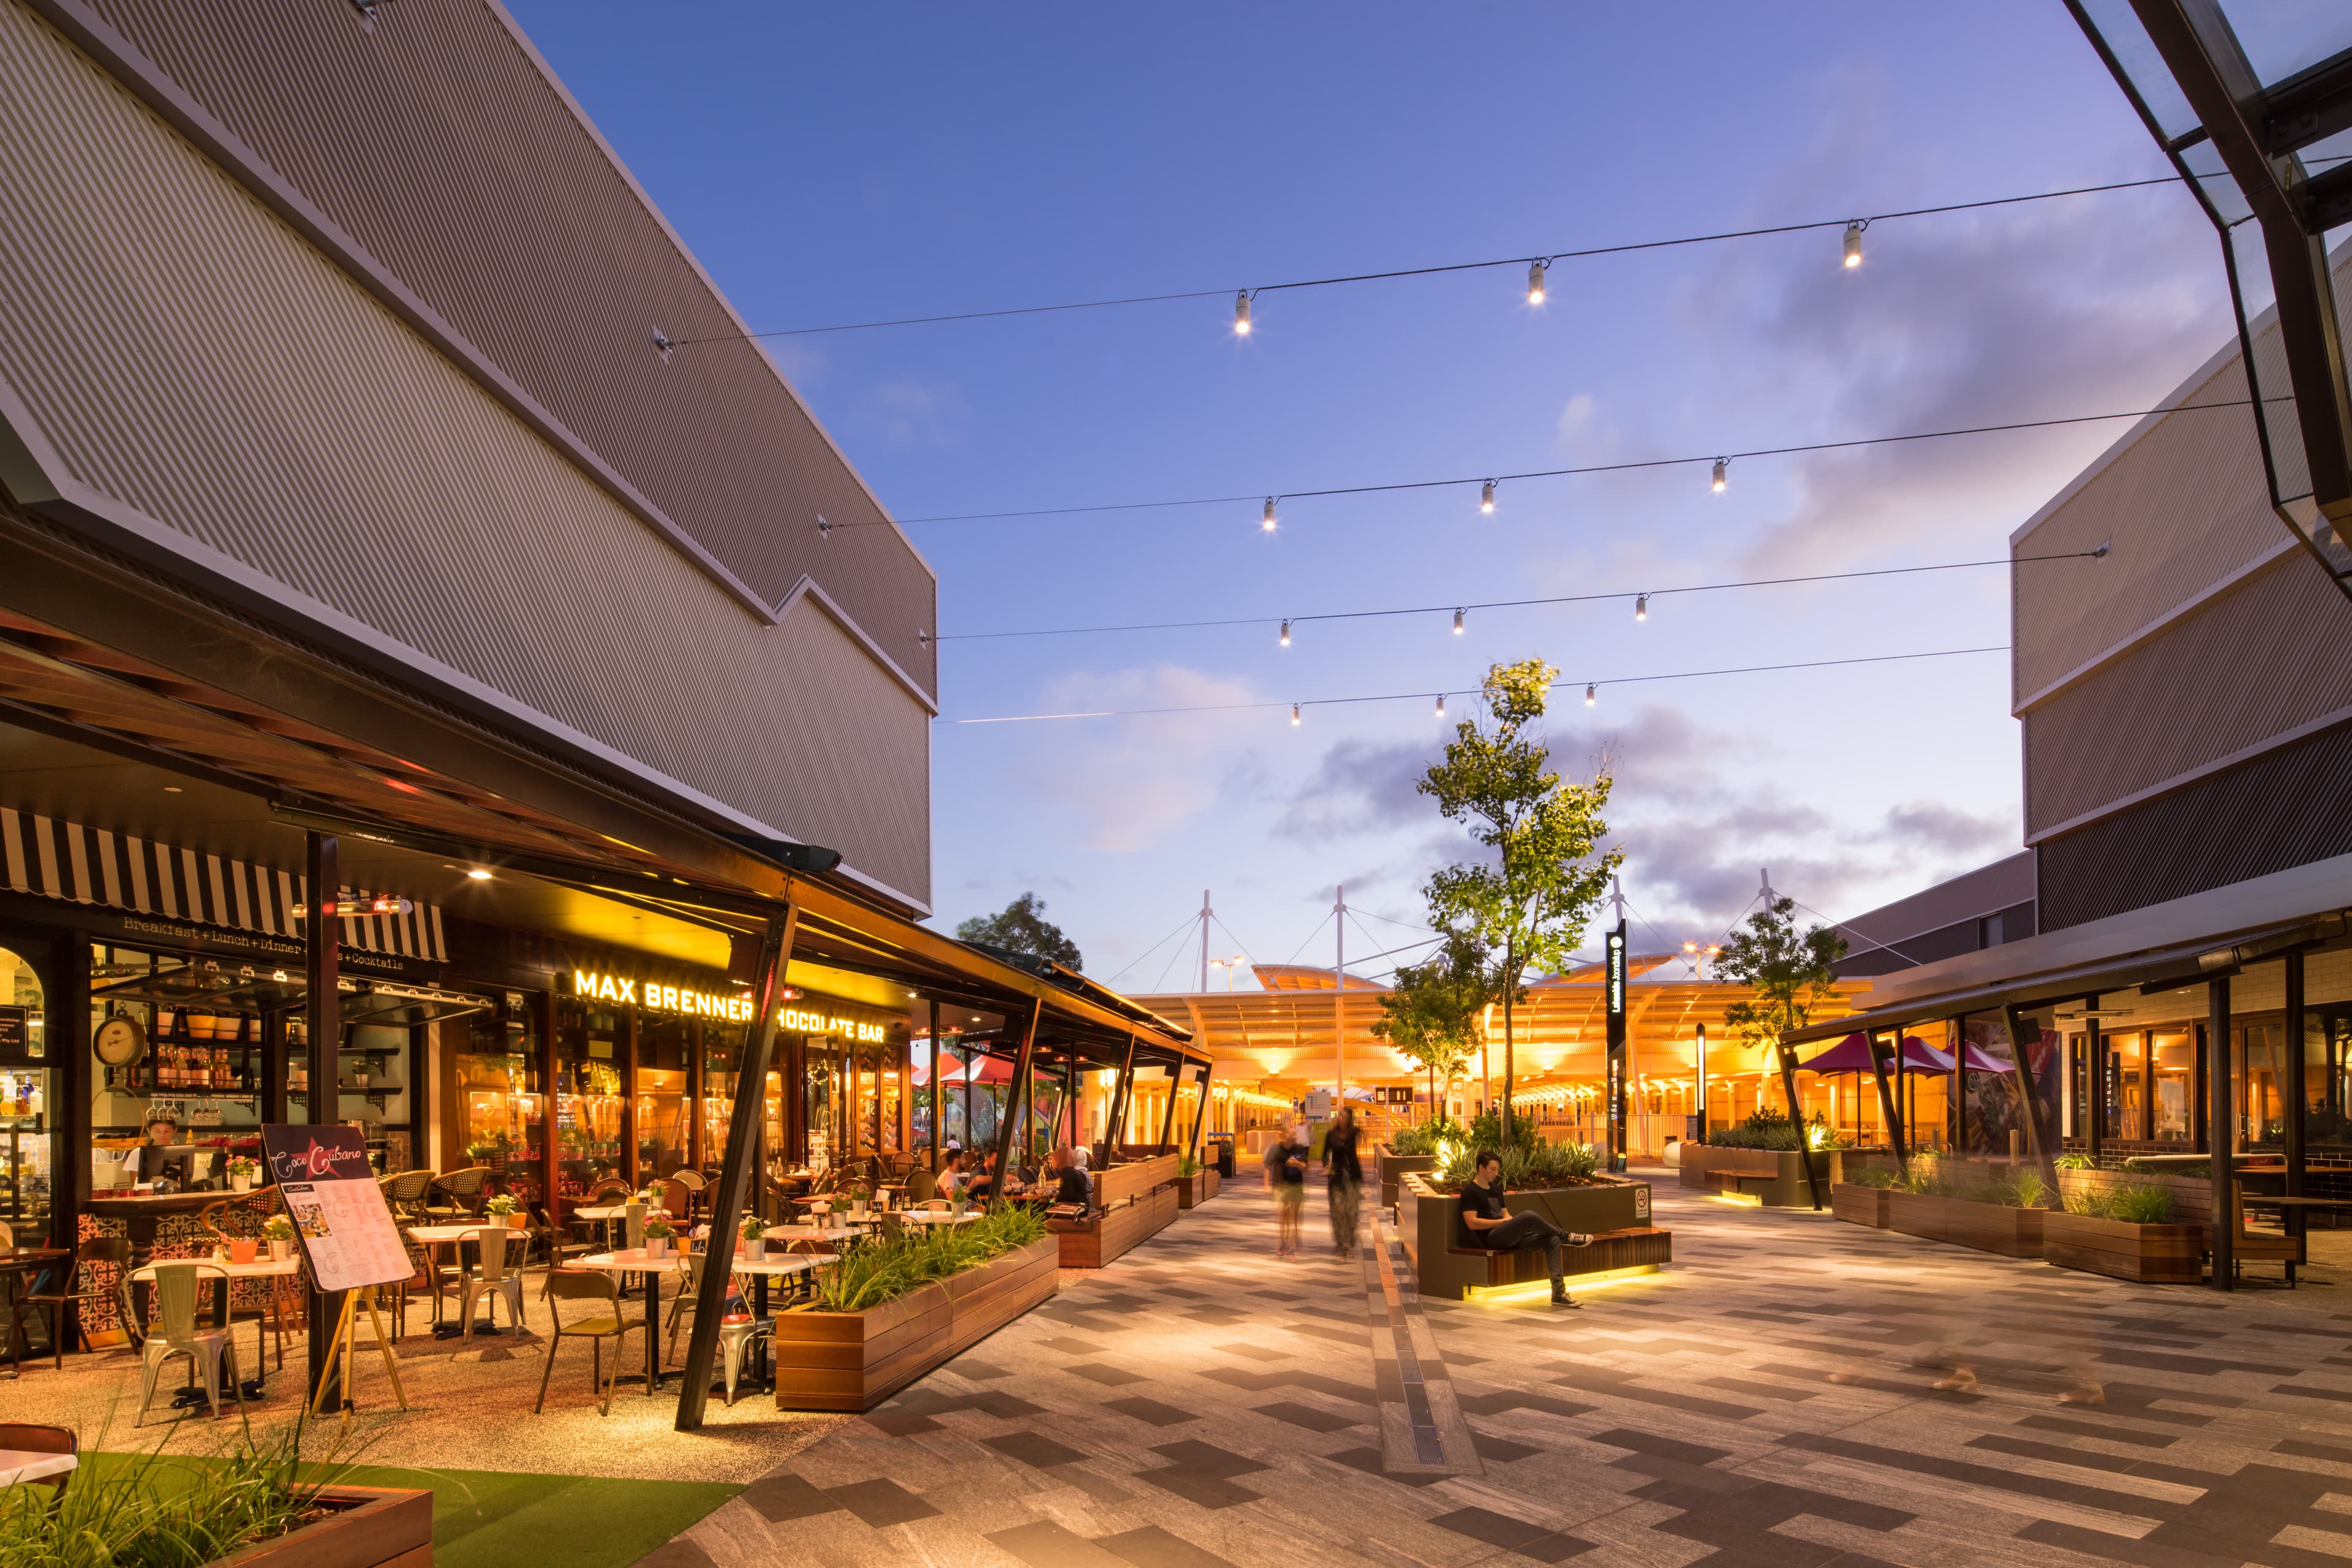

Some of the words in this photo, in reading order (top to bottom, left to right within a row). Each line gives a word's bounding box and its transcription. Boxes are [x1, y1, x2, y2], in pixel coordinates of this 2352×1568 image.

[124, 916, 198, 939] Breakfast
[212, 930, 249, 947] Lunch
[260, 940, 301, 954] Dinner
[352, 953, 404, 970] Cocktails
[1612, 949, 1621, 981] Joondalup
[576, 970, 636, 1003] MAX
[645, 983, 753, 1021] BRENNER
[858, 1022, 884, 1042] BAR
[1612, 981, 1621, 1012] Lakeside
[270, 1152, 307, 1178] Coco
[310, 1145, 361, 1175] Cubano
[692, 1240, 705, 1253] 46
